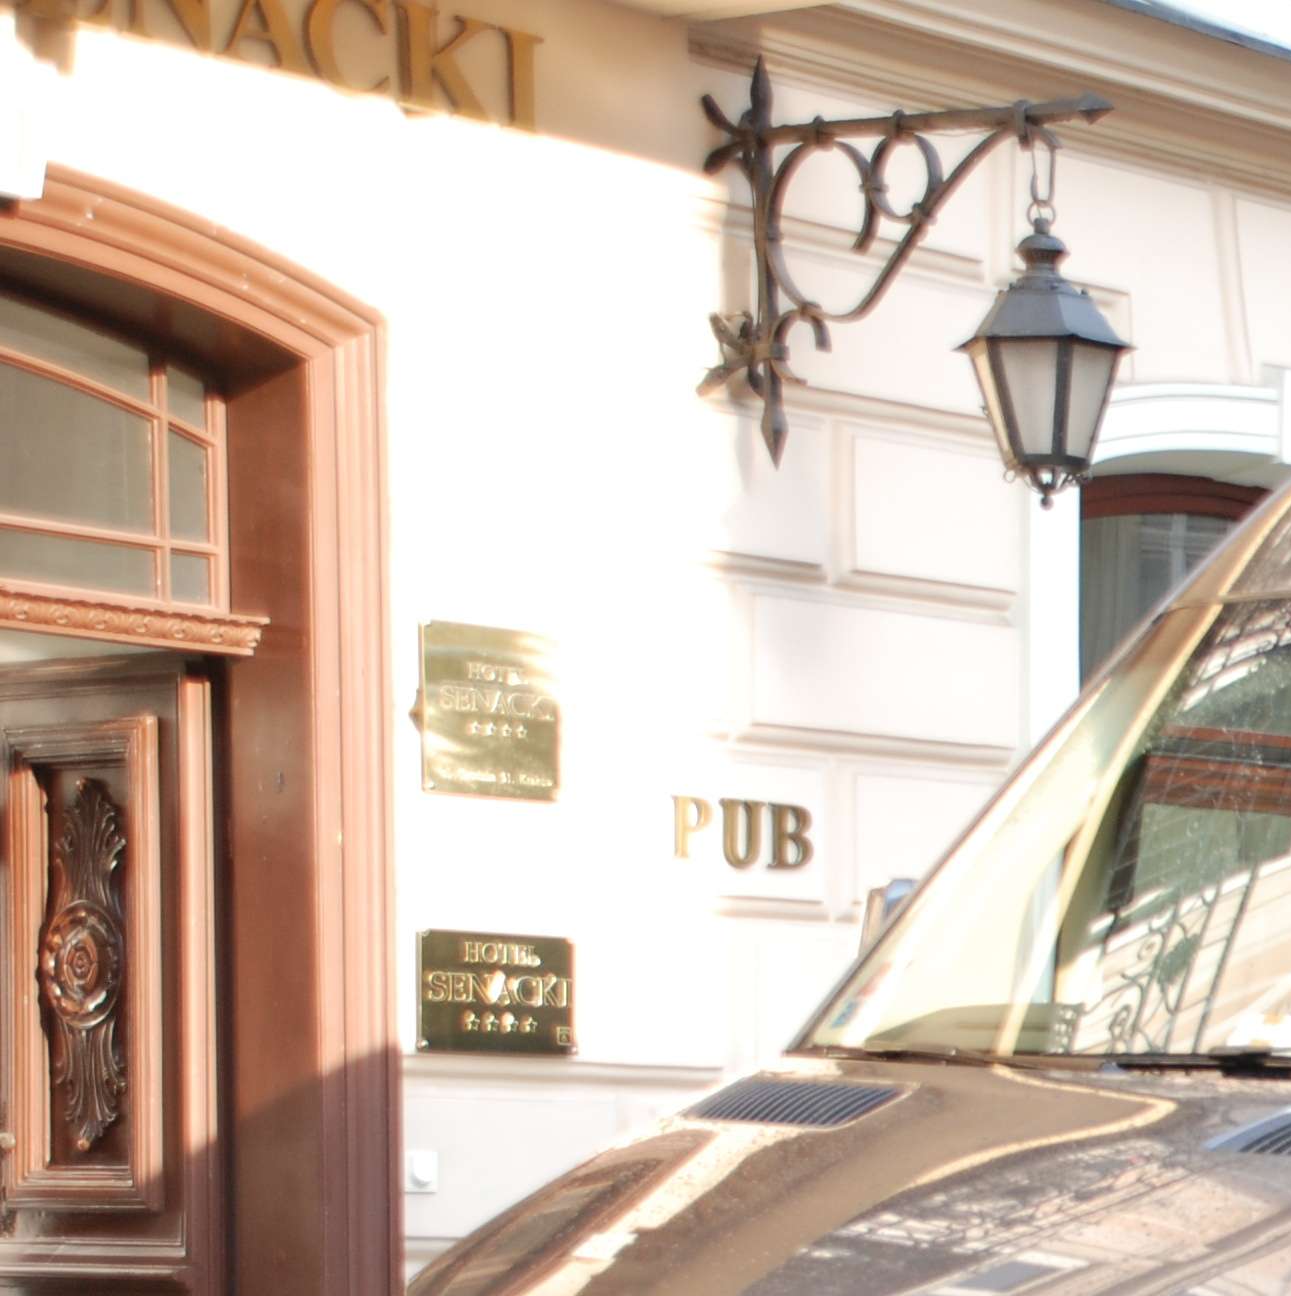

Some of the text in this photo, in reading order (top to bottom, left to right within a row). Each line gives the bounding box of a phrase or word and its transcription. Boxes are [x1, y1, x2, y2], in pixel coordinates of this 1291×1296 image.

[671, 795, 814, 870] PUB
[464, 941, 541, 967] HOTEL
[428, 970, 574, 1008] SENACKI
